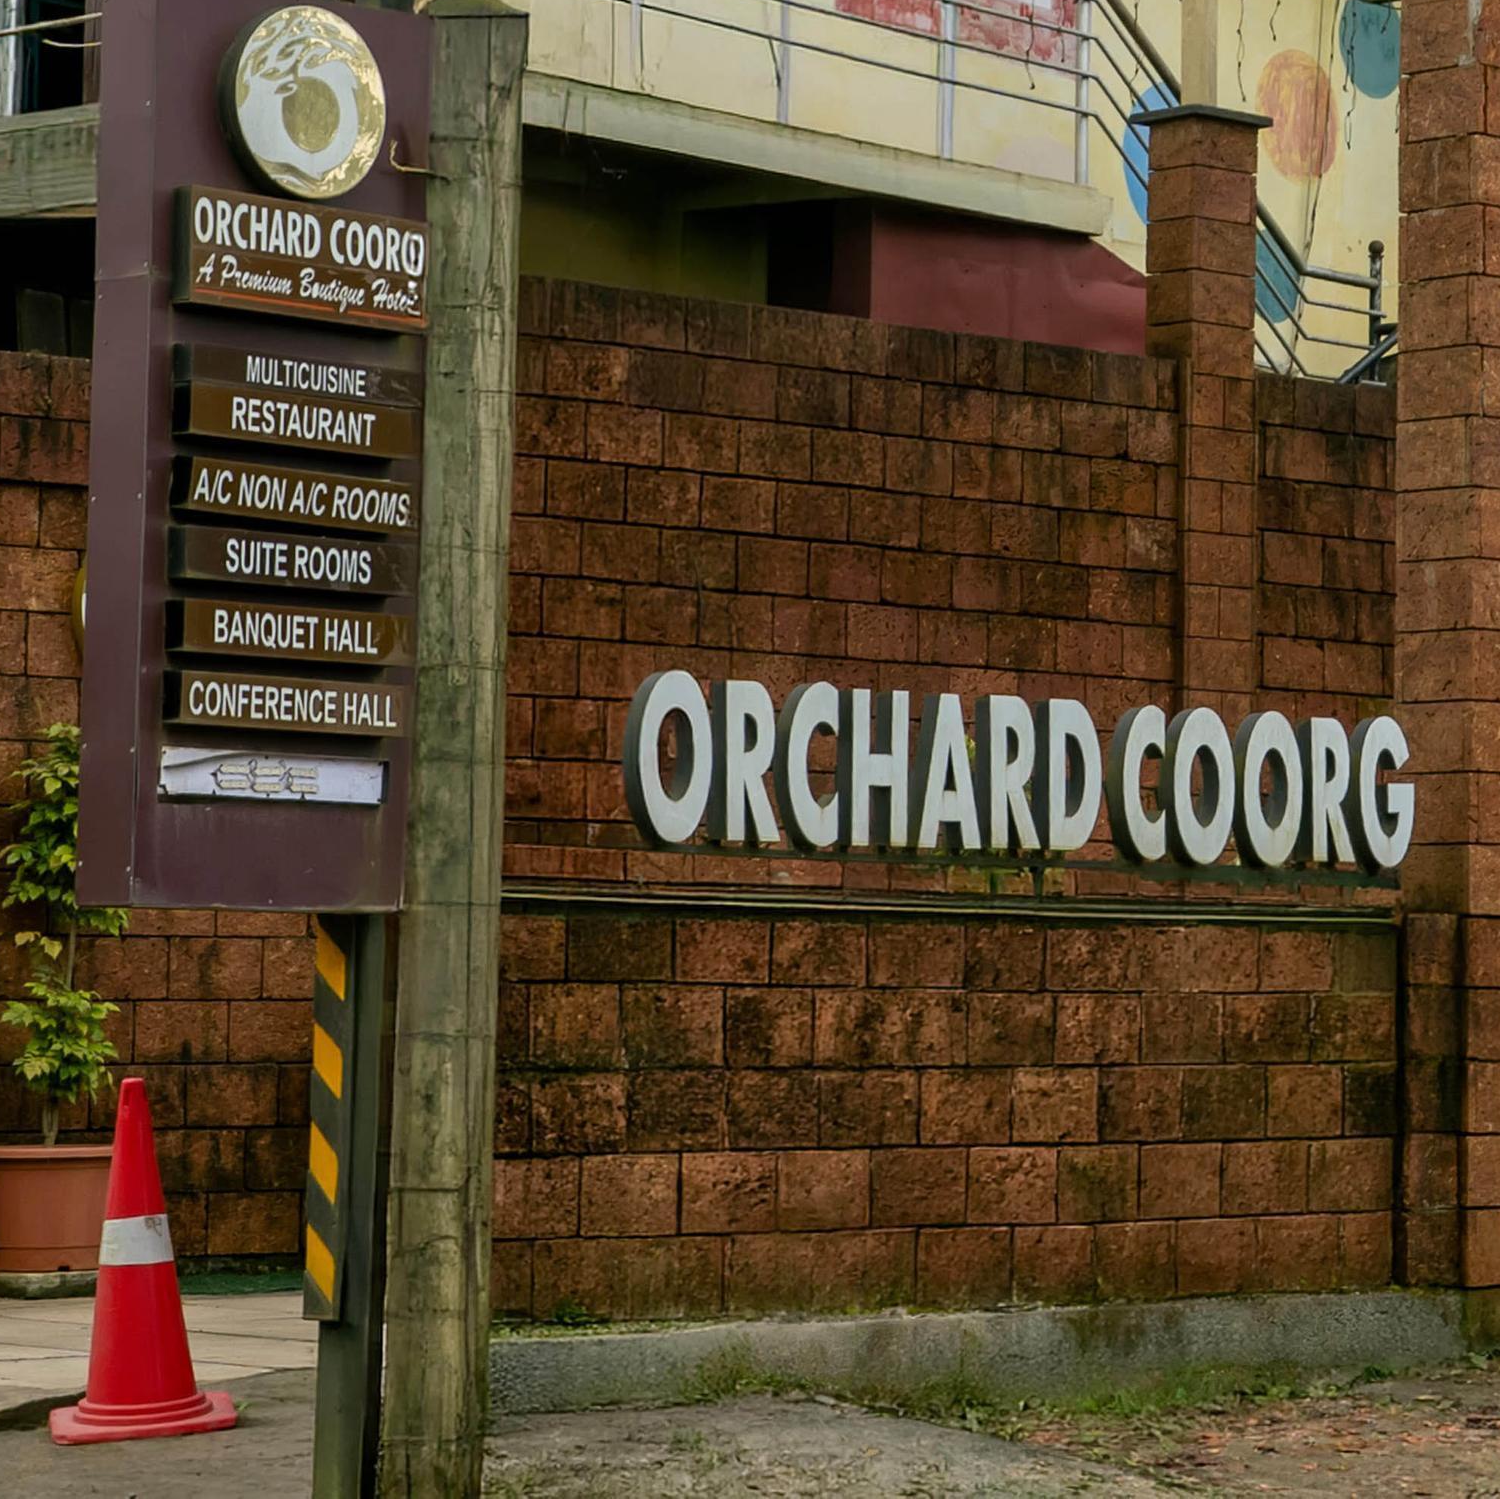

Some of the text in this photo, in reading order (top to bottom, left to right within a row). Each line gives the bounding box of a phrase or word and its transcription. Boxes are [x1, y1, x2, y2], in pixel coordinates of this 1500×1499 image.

[194, 196, 321, 259] ORCHARD
[195, 252, 216, 283] A
[220, 254, 293, 300] Premium
[299, 267, 365, 313] Boutique
[246, 355, 366, 397] MULTICUISINE
[231, 396, 376, 446] RESTAURANT
[194, 467, 411, 527] A/C NON A/C ROOMS
[225, 537, 372, 585] SUITE ROOMS
[214, 608, 378, 655] BANQUET HALL
[188, 680, 397, 728] CONFERENCE HALL
[623, 669, 1417, 869] ORCHARD COORG
